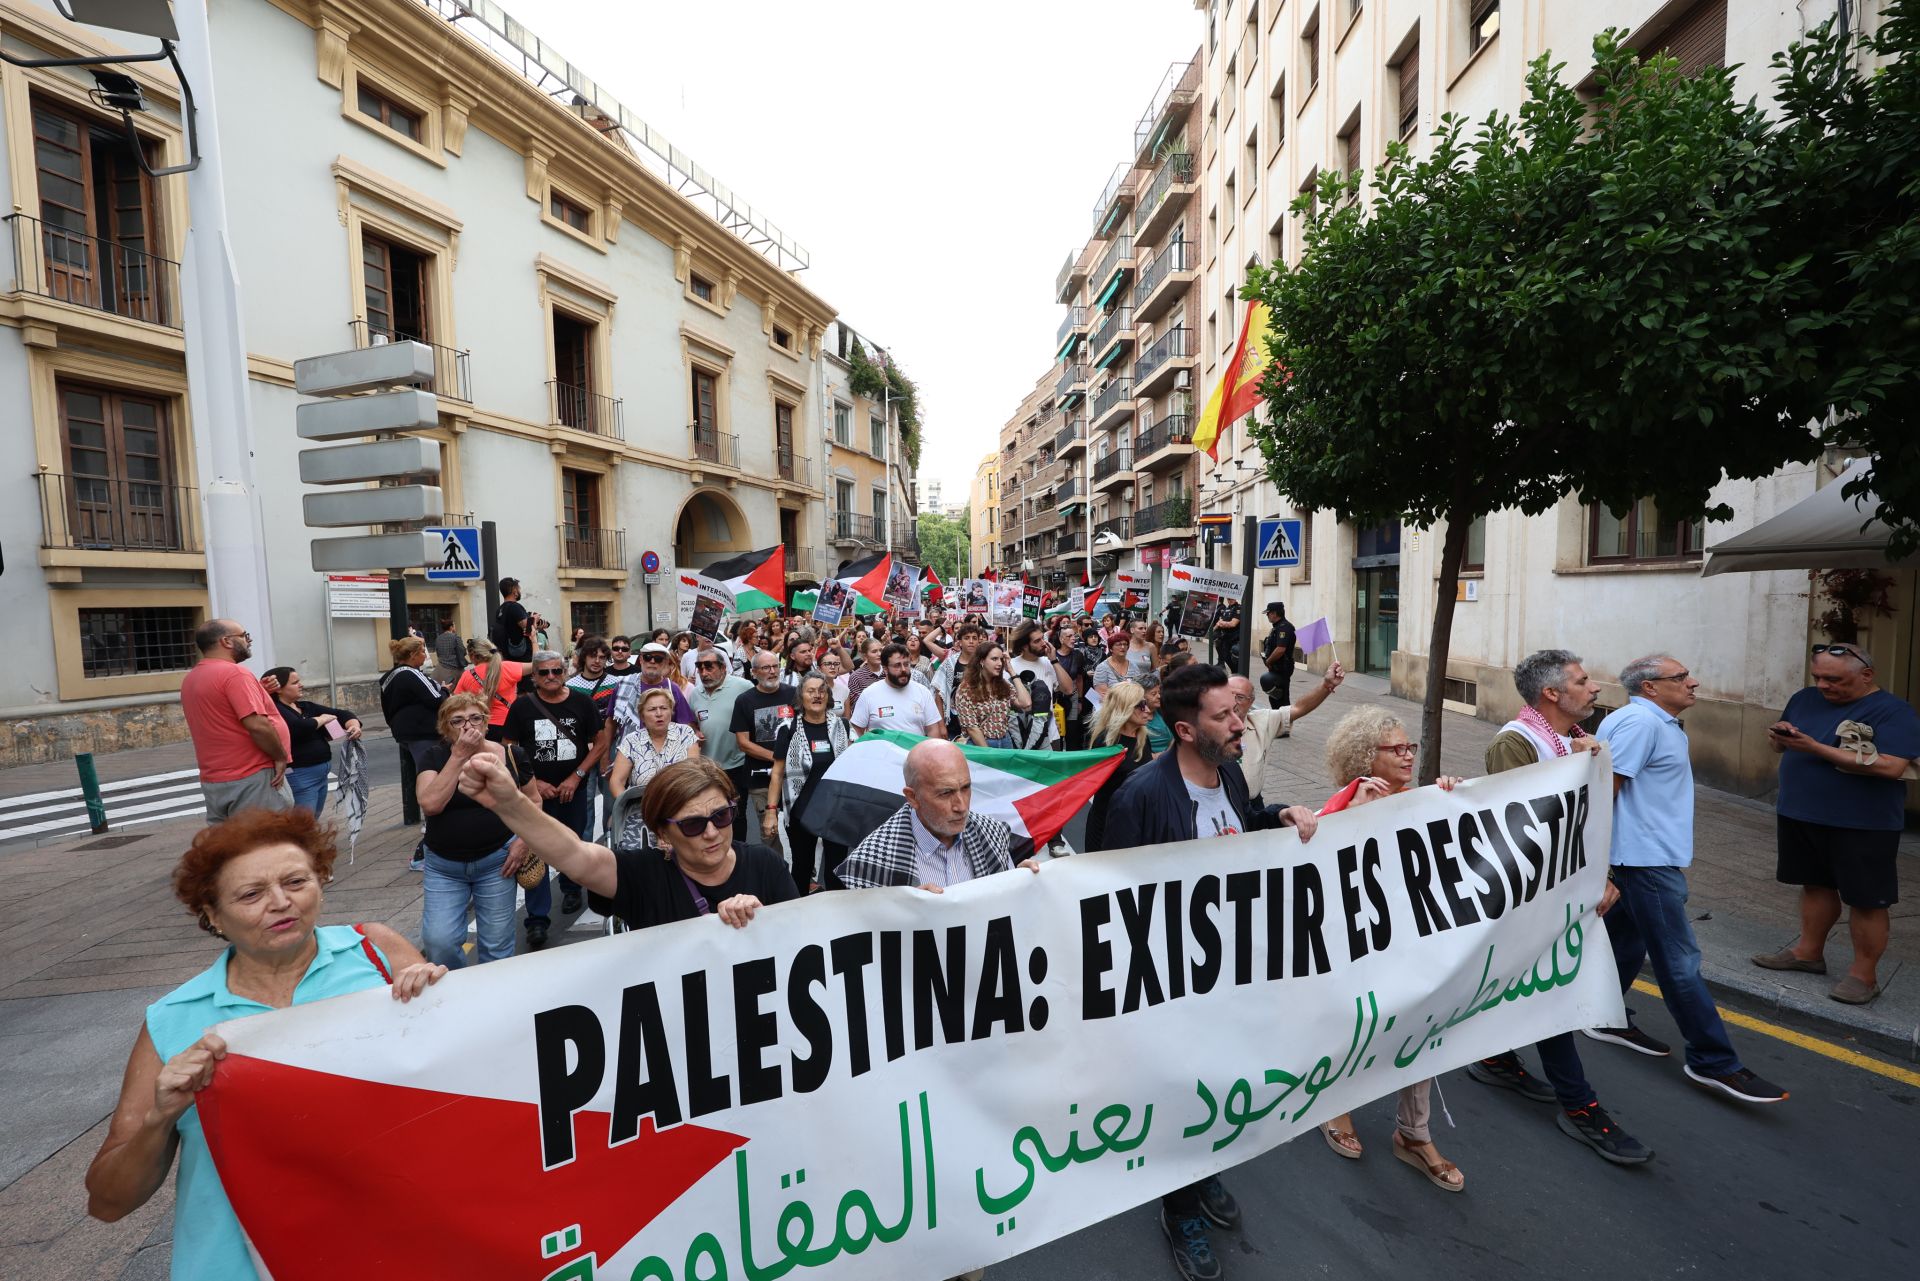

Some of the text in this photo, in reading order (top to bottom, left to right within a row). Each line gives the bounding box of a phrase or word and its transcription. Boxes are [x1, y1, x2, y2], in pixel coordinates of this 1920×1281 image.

[1192, 576, 1242, 591] INTERSINDICA
[534, 784, 1587, 1169] PALESTINA: EXISTIR ES RESISTIR
[975, 1102, 1153, 1234] يعني
